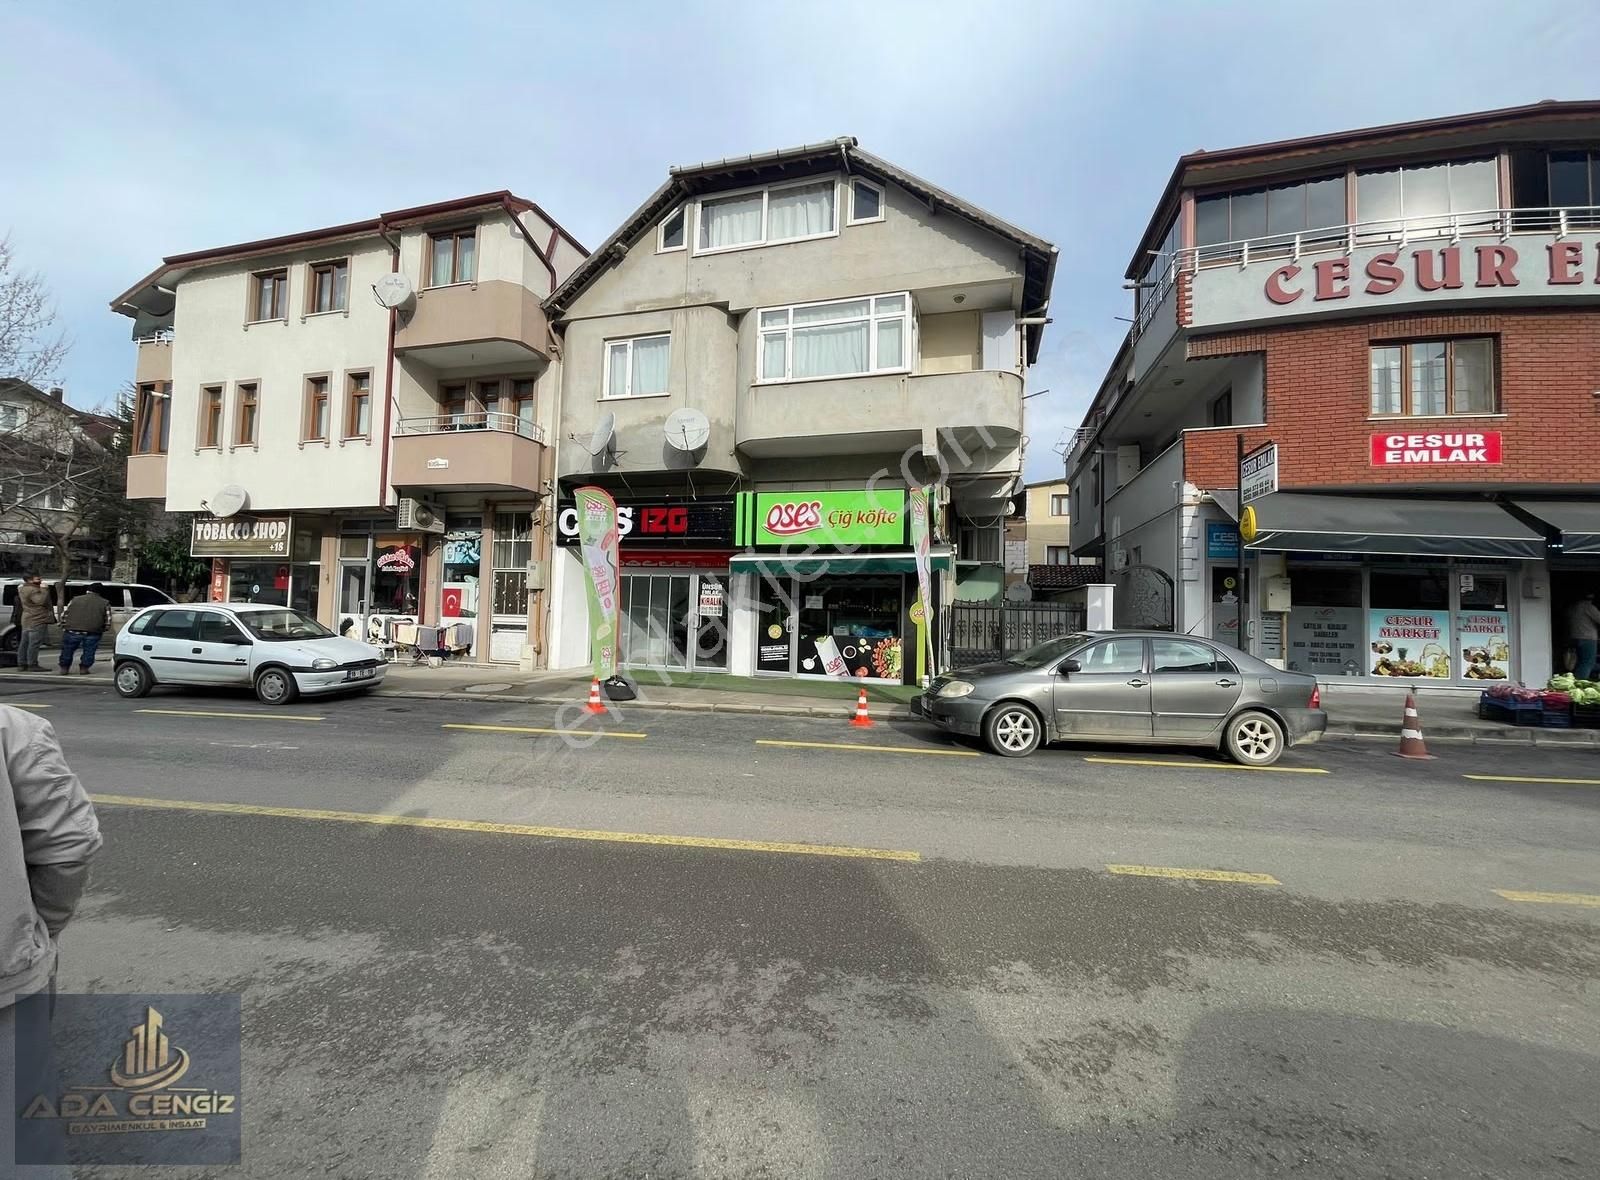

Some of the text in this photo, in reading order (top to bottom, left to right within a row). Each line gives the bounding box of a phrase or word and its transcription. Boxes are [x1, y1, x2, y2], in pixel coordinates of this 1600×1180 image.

[1265, 241, 1600, 304] CESUR E
[1385, 433, 1485, 448] CESUR
[1385, 448, 1488, 463] EMLAK
[641, 508, 688, 533] IZG
[828, 510, 853, 528] Çiğ
[856, 508, 897, 528] köfte
[196, 521, 287, 541] TOBACCO SHOP
[269, 541, 285, 552] +18
[1385, 616, 1433, 627] CESUR
[1379, 627, 1441, 639] MARKET
[1463, 625, 1506, 634] MARKET
